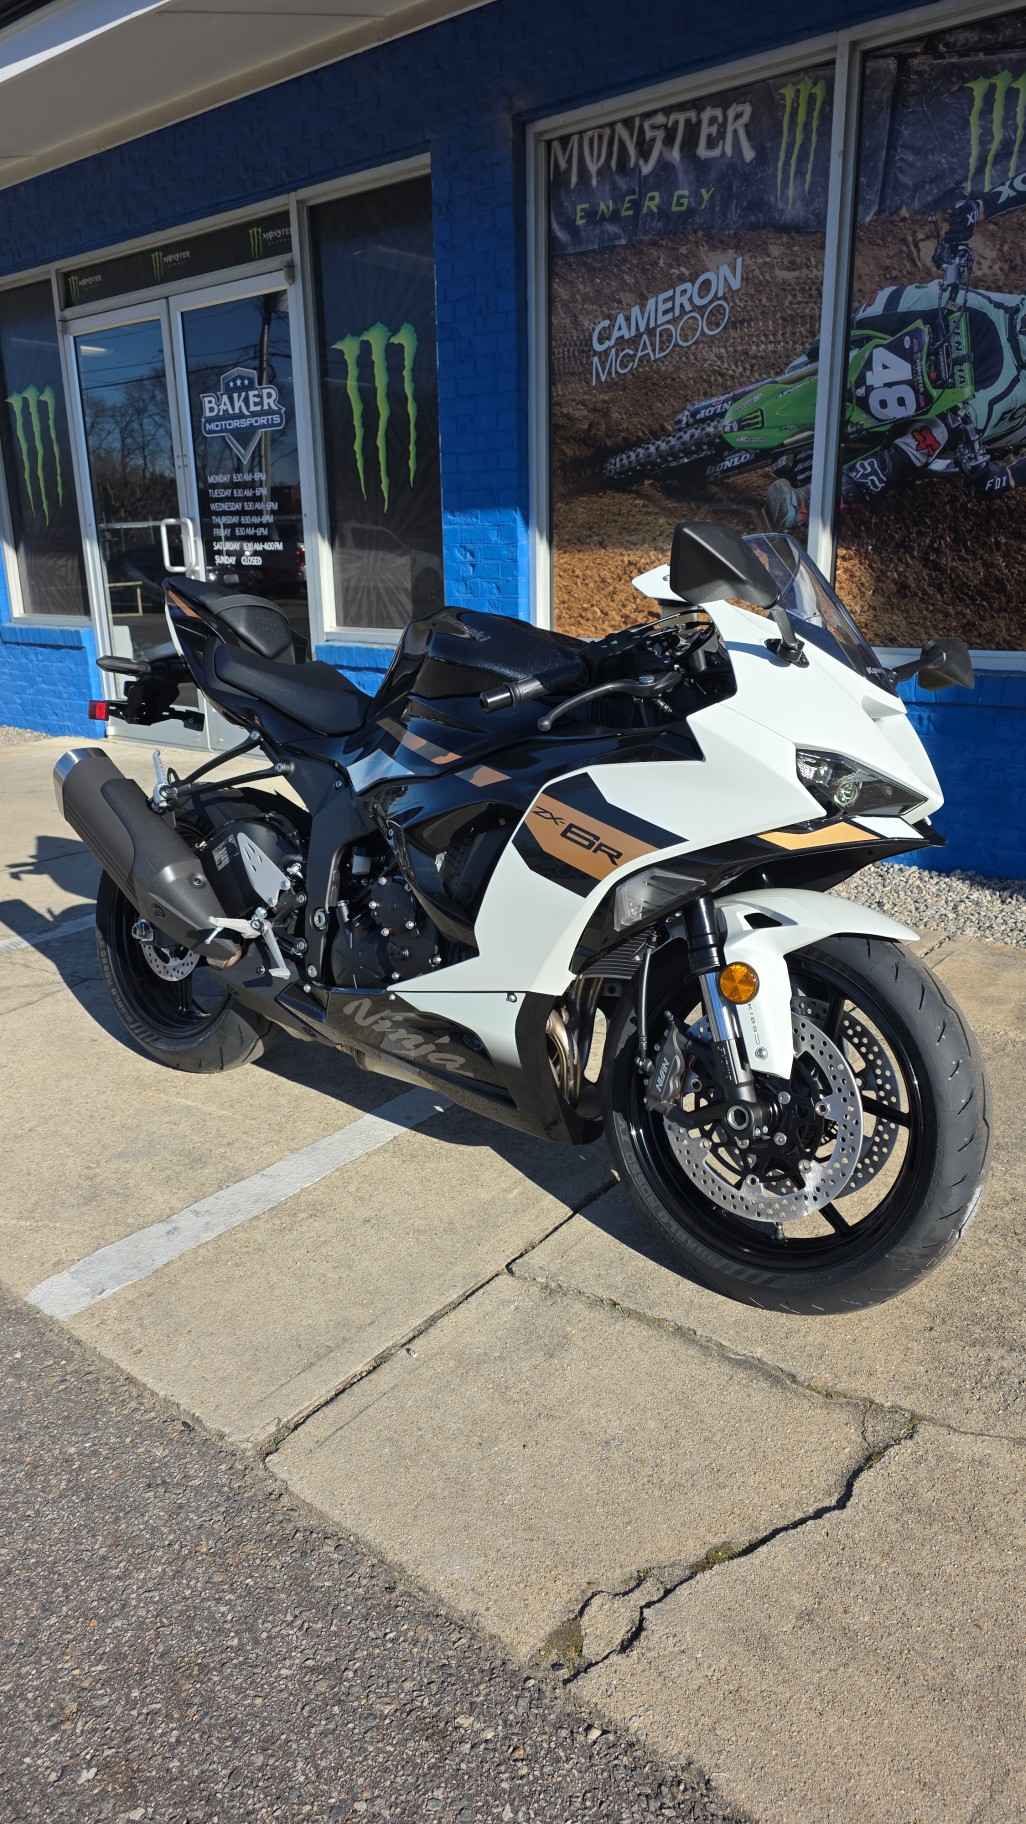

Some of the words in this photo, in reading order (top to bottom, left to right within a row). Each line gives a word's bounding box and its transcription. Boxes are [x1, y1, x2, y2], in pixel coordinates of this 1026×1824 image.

[551, 102, 757, 189] MONSTER
[575, 187, 716, 226] ENERGY
[592, 256, 743, 352] CAMERON
[866, 347, 917, 421] 48
[203, 388, 279, 417] BAKER
[205, 415, 281, 431] MOTORSPORTS
[208, 488, 232, 497] TUESDAY
[210, 502, 242, 511] WEDNESDAY
[213, 541, 241, 551] SATURDAY
[214, 555, 237, 565] SUNDAY
[240, 556, 262, 566] CLOSED
[342, 997, 475, 1079] Ninja
